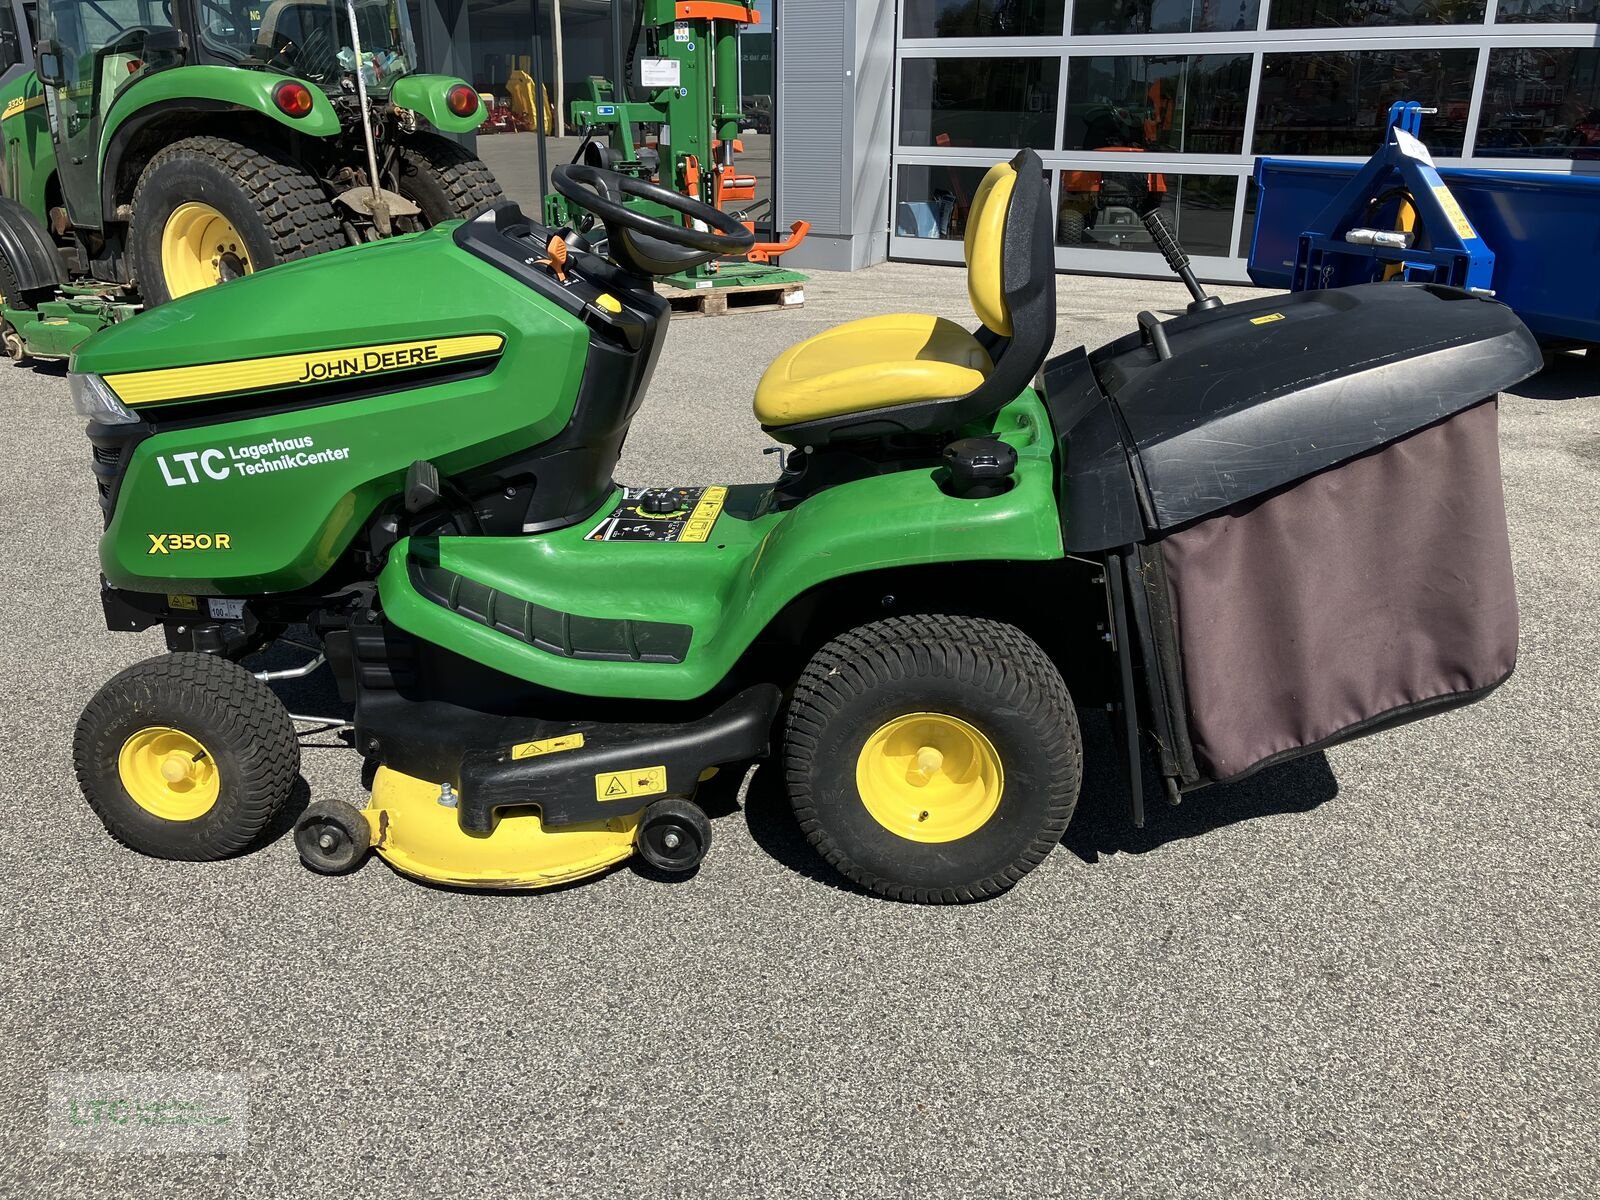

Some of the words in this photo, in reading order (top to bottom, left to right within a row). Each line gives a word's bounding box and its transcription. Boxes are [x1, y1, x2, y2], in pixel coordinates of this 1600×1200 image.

[298, 357, 359, 381] JOHN
[363, 345, 438, 370] DEERE
[228, 436, 314, 460] Lagerhaus
[234, 447, 350, 476] TechnikCenter
[156, 448, 231, 487] LTC
[212, 607, 224, 617] 100
